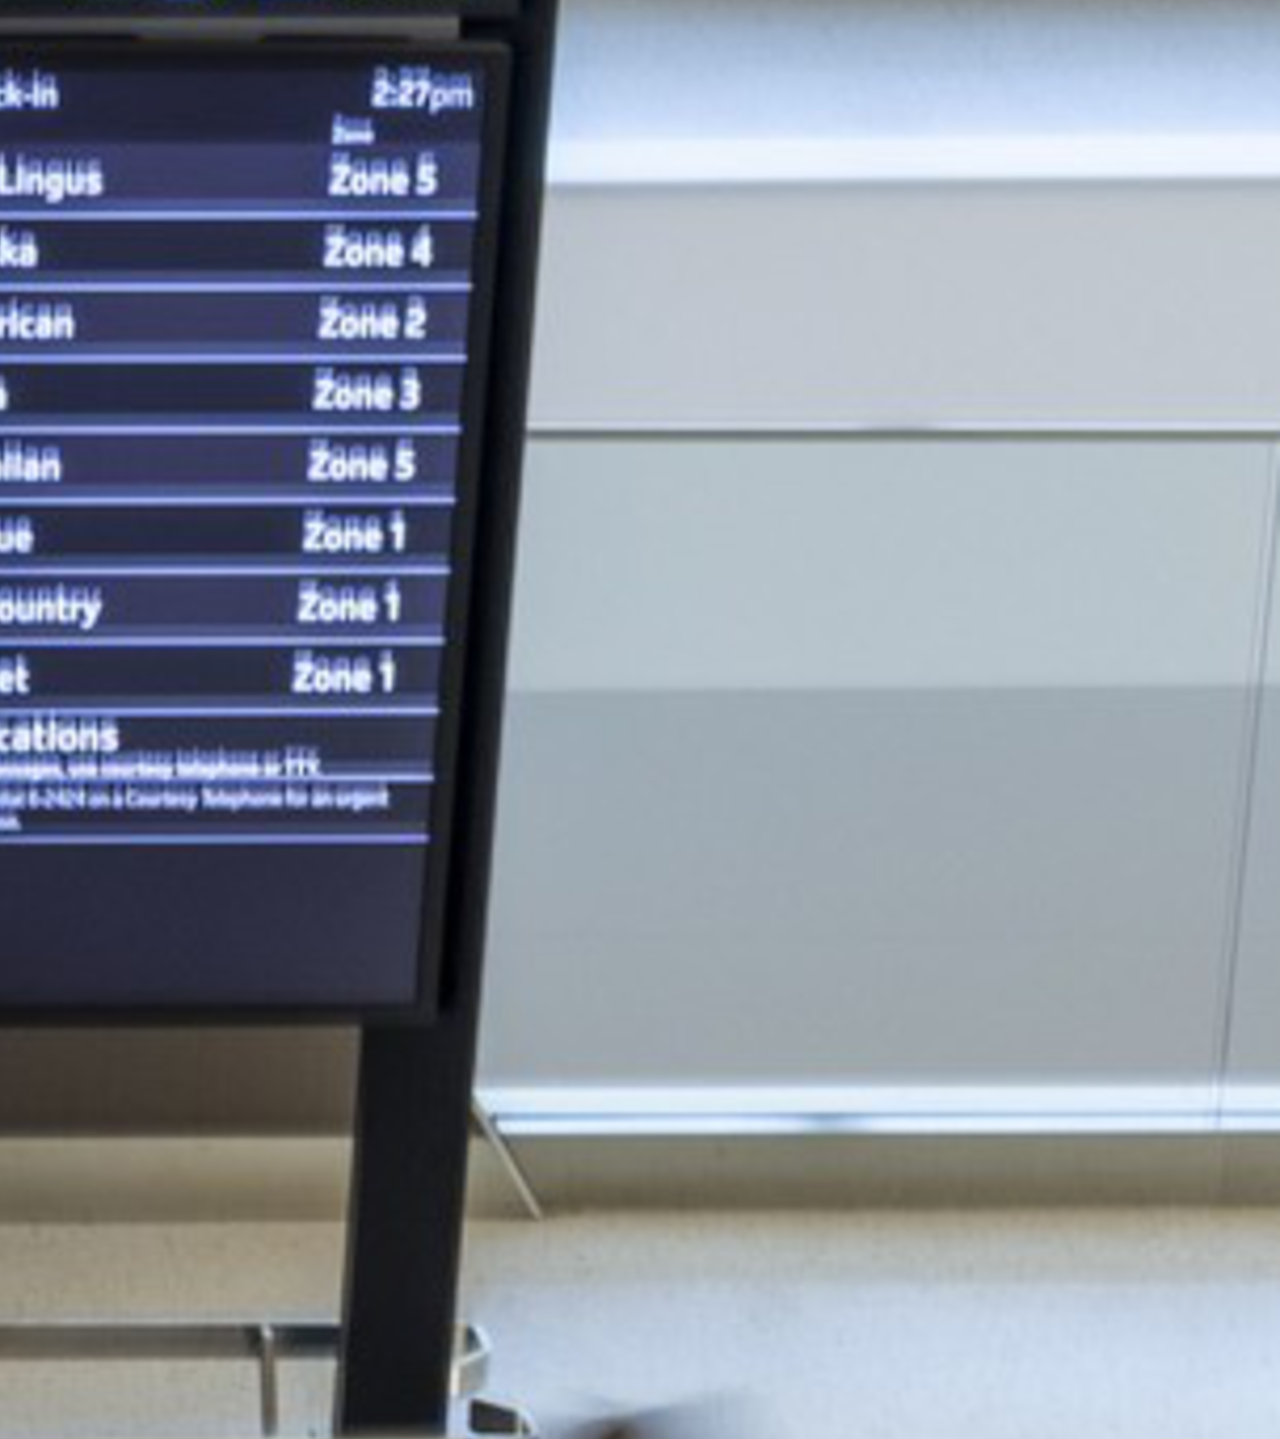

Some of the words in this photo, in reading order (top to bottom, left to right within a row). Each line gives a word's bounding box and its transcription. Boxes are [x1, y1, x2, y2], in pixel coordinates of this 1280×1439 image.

[370, 69, 474, 112] 2:27pm
[328, 154, 410, 197] Zone
[415, 154, 437, 196] 5
[324, 228, 404, 268] Zone
[411, 227, 433, 267] 4
[318, 300, 399, 340] Zone
[404, 299, 427, 339] 2
[312, 371, 393, 411] Zone
[398, 370, 422, 410] 3
[308, 443, 389, 482] Zone
[394, 443, 416, 481] 5
[302, 512, 384, 552] Zone
[389, 512, 406, 551] 1
[297, 582, 378, 622] Zone
[384, 582, 400, 621] 1
[292, 651, 373, 693] Zone
[379, 652, 395, 692] 1
